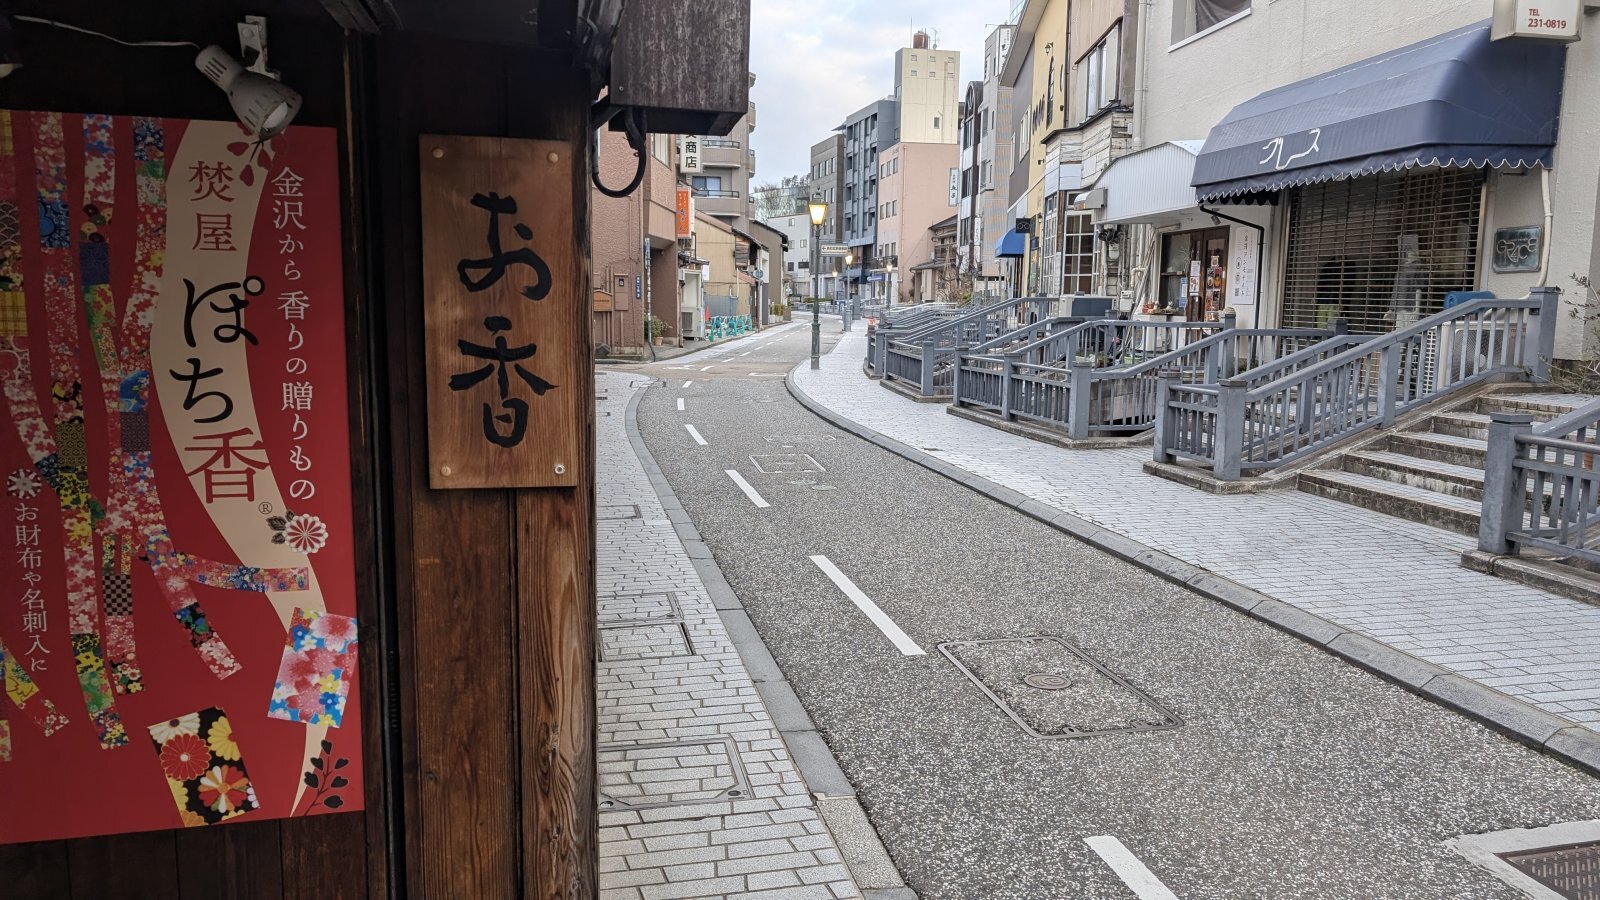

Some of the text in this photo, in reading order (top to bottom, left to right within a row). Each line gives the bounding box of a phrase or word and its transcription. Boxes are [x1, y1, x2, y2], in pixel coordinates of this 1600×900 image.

[1528, 18, 1567, 29] 231-0819
[685, 134, 697, 169] 商店
[270, 166, 316, 500] 金沢から香りの贈りもの
[448, 191, 558, 448] お香
[14, 502, 51, 673] お財布や名刺入に
